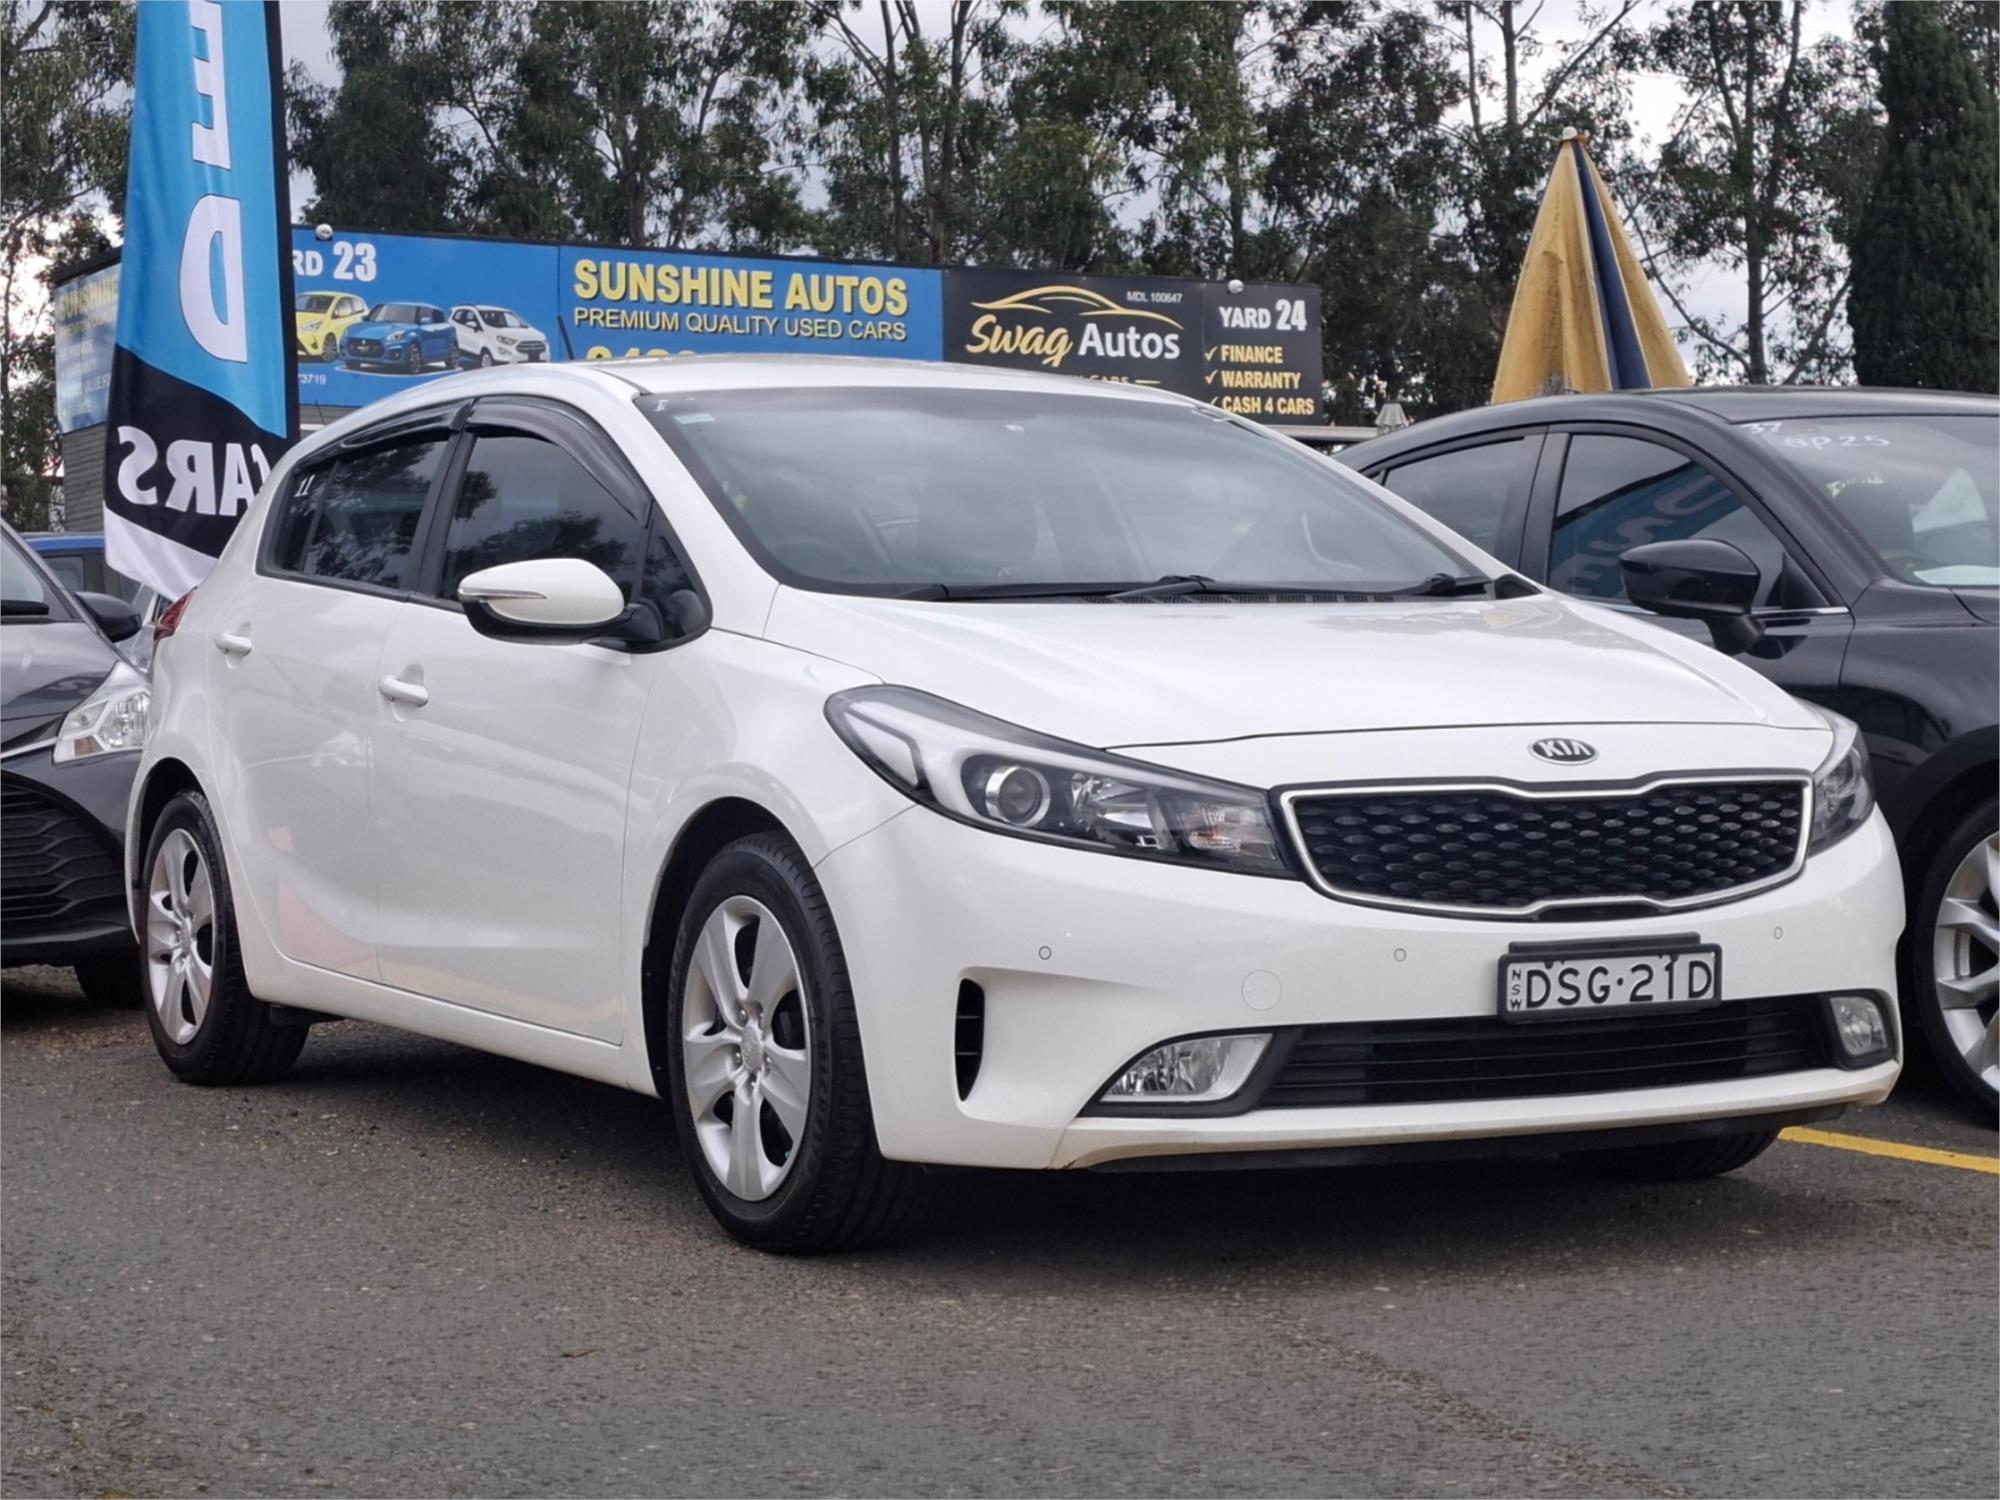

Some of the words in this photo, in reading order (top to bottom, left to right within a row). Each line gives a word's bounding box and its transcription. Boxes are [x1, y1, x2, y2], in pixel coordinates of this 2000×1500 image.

[332, 241, 377, 282] 23
[574, 258, 774, 310] SUNSHINE
[784, 272, 909, 317] AUTOS
[574, 307, 680, 332] PREMIUM
[685, 312, 780, 335] QUALITY
[784, 317, 843, 338] USED
[848, 319, 907, 341] CARS
[1219, 306, 1271, 329] YARD
[1275, 299, 1308, 331] 24
[966, 314, 1073, 367] Swag
[1078, 323, 1181, 360] Autos
[1220, 344, 1284, 364] FINANCE
[1220, 369, 1302, 389] WARRANTY
[1222, 396, 1261, 414] CASH
[1265, 397, 1274, 414] 4
[1277, 397, 1315, 416] CARS
[1538, 740, 1593, 757] KIA
